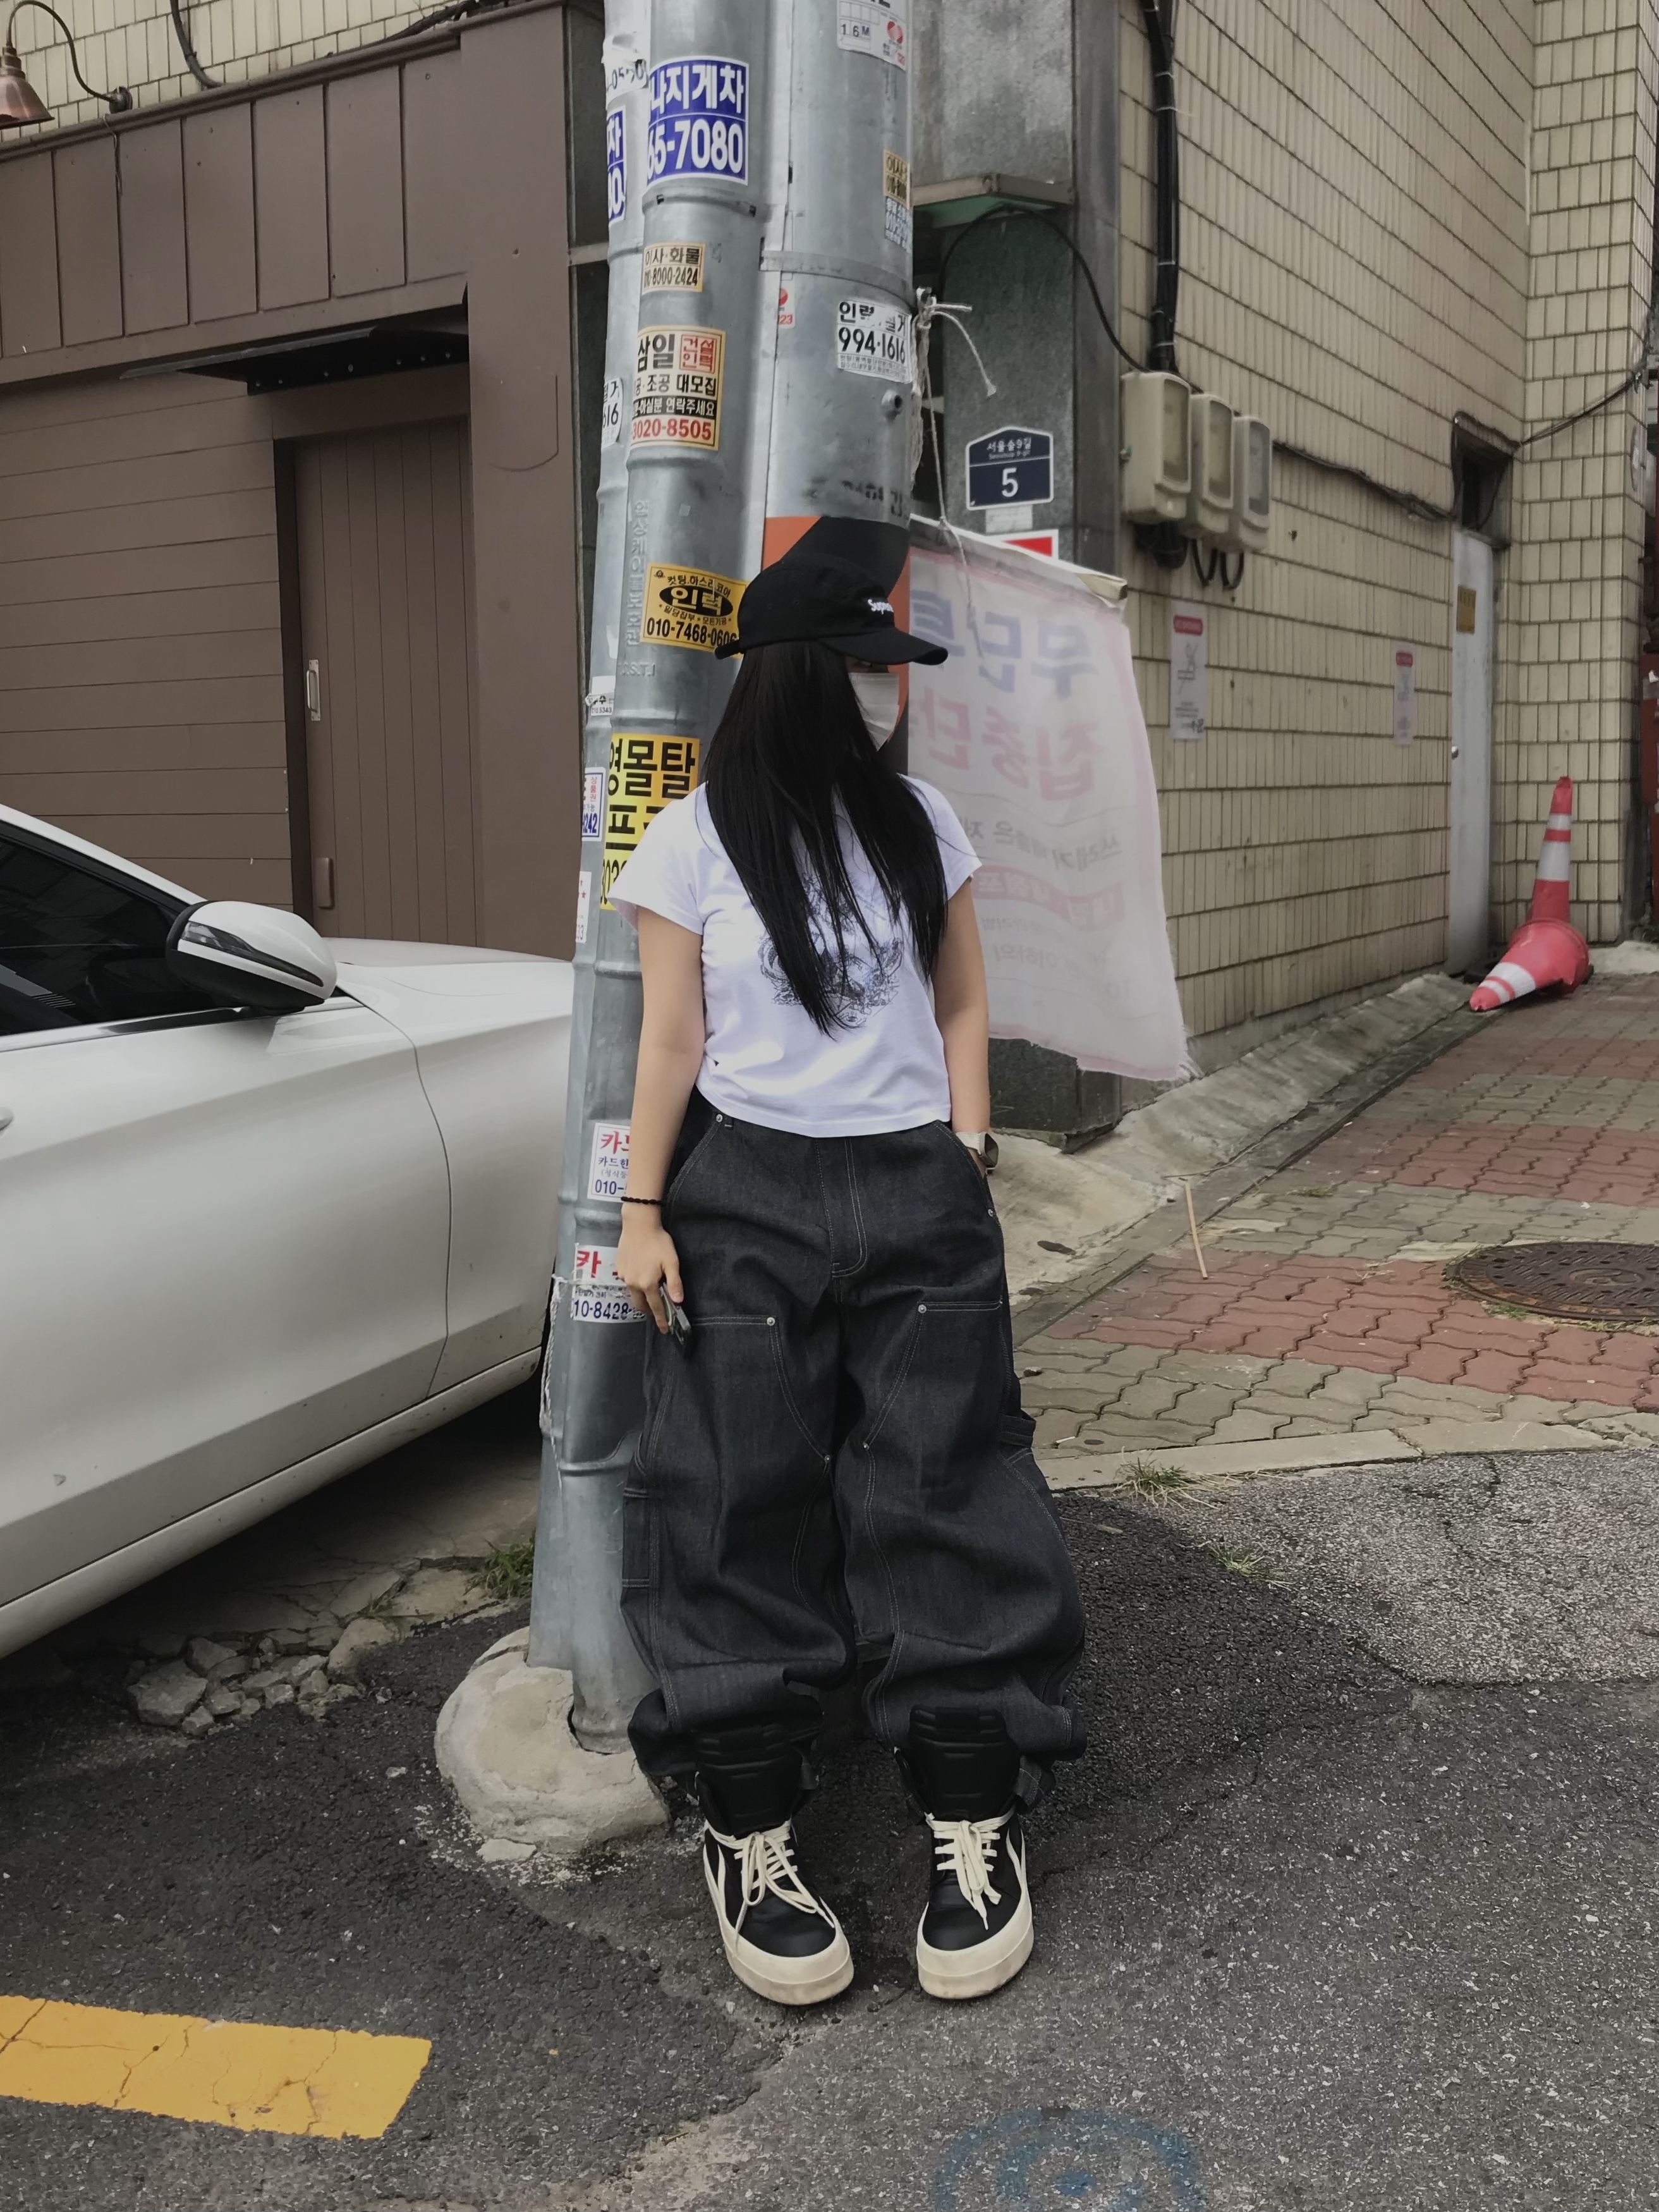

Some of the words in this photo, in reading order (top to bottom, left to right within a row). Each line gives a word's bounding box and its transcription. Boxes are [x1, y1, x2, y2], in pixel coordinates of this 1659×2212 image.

[638, 334, 675, 372] 삼일
[677, 374, 716, 396] 대모집
[666, 397, 714, 416] 연락주세요
[1002, 467, 1018, 498] 5
[671, 587, 722, 616] 인력
[583, 812, 598, 833] 242
[595, 1179, 627, 1195] 010-
